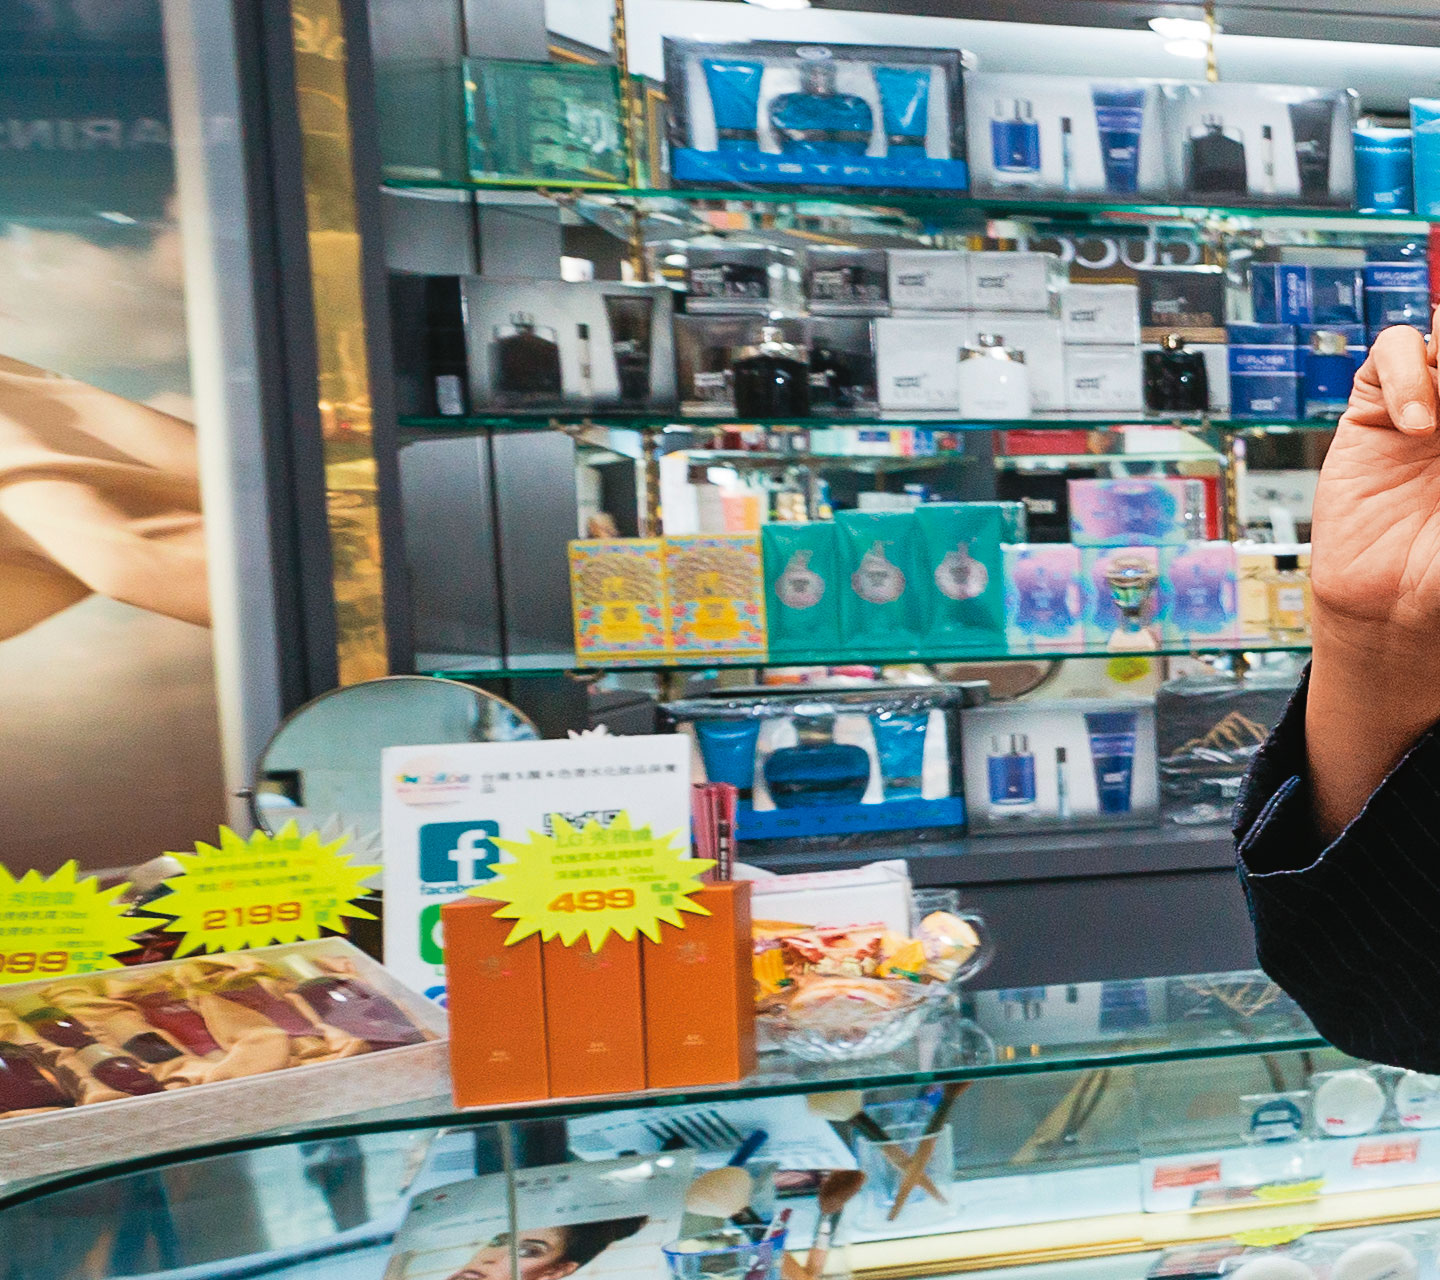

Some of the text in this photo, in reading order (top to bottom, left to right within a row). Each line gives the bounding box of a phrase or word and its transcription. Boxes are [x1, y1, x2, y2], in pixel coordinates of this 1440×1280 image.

[548, 888, 635, 914] 499
[203, 901, 302, 931] 2199
[0, 950, 69, 974] 99
